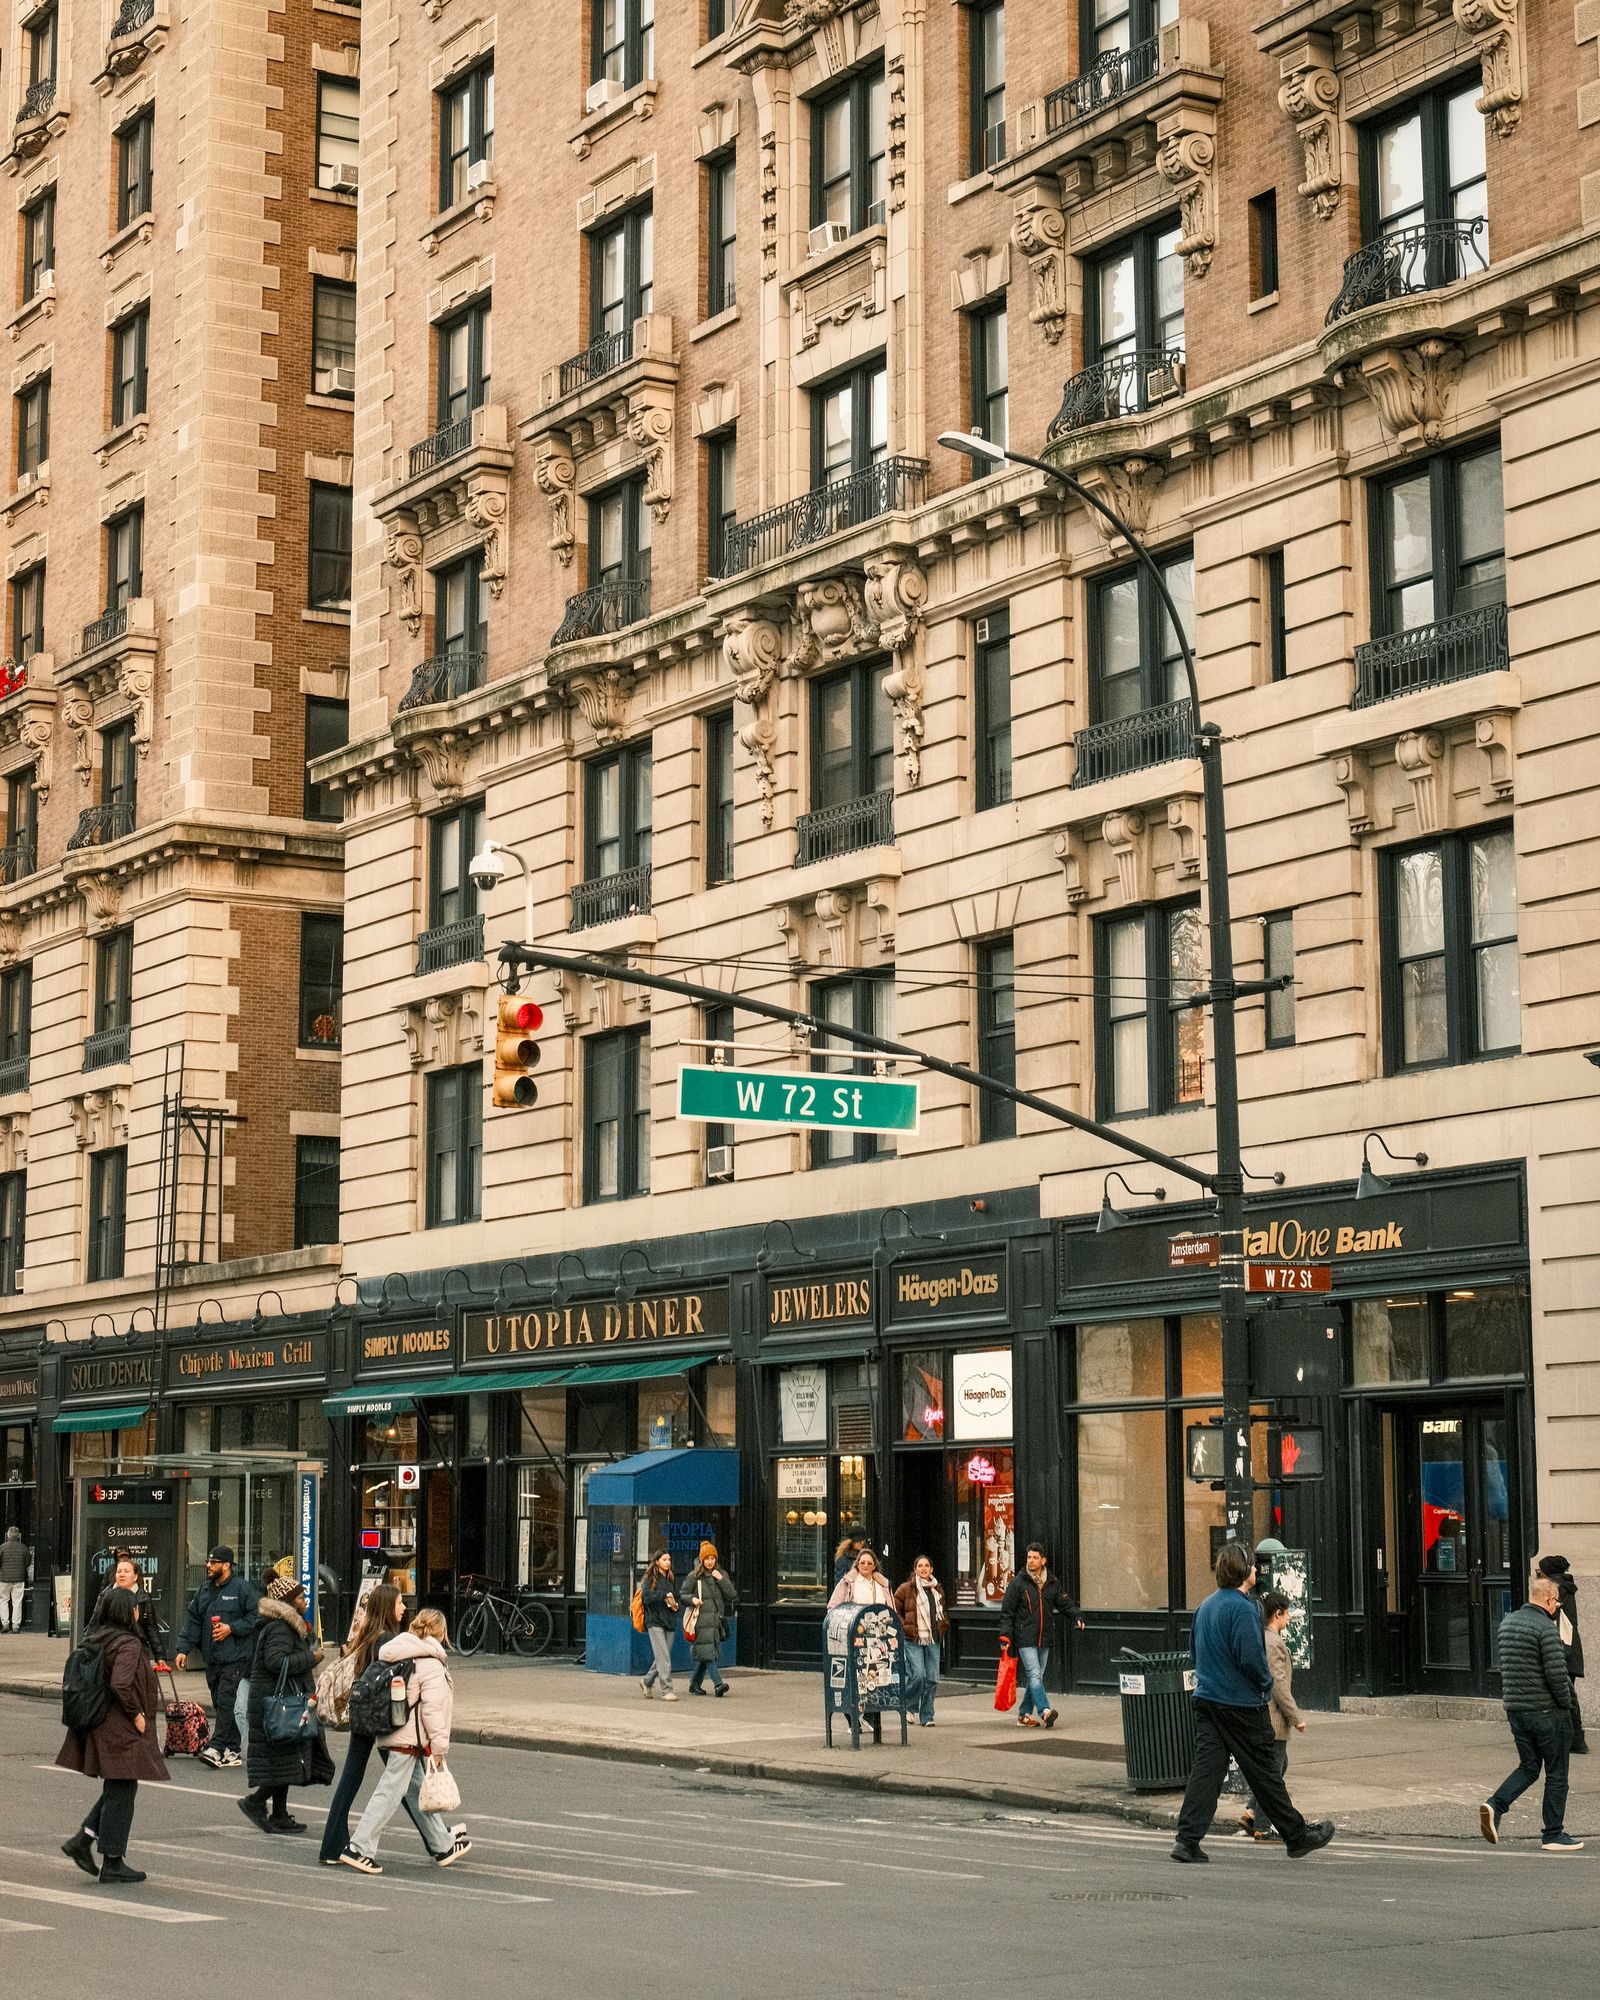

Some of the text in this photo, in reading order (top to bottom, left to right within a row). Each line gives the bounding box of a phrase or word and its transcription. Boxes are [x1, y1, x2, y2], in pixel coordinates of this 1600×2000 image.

[736, 1081, 863, 1119] W 72 St
[1171, 1241, 1210, 1257] Amsterdam
[1335, 1221, 1404, 1254] Bank
[898, 1268, 999, 1307] Häagen-Dazs
[1265, 1269, 1312, 1289] W 72 St
[771, 1279, 870, 1324] JEWELERS
[485, 1295, 705, 1354] UTOPIA DINER
[364, 1329, 450, 1358] SIMPLY NOODLES
[179, 1341, 312, 1378] Chipotle Mexican Grill
[71, 1359, 152, 1391] SOUL DENTAL
[347, 1402, 392, 1413] SIMPLY NOODLES
[802, 1485, 824, 1493] DIAMONDS
[302, 1479, 312, 1534] Amsterdam
[659, 1522, 716, 1537] UTOPIA
[960, 1524, 967, 1540] A
[302, 1536, 312, 1571] Avenue
[666, 1539, 701, 1551] DINE
[147, 1557, 158, 1574] IN
[302, 1573, 311, 1582] &
[302, 1582, 311, 1596] 72
